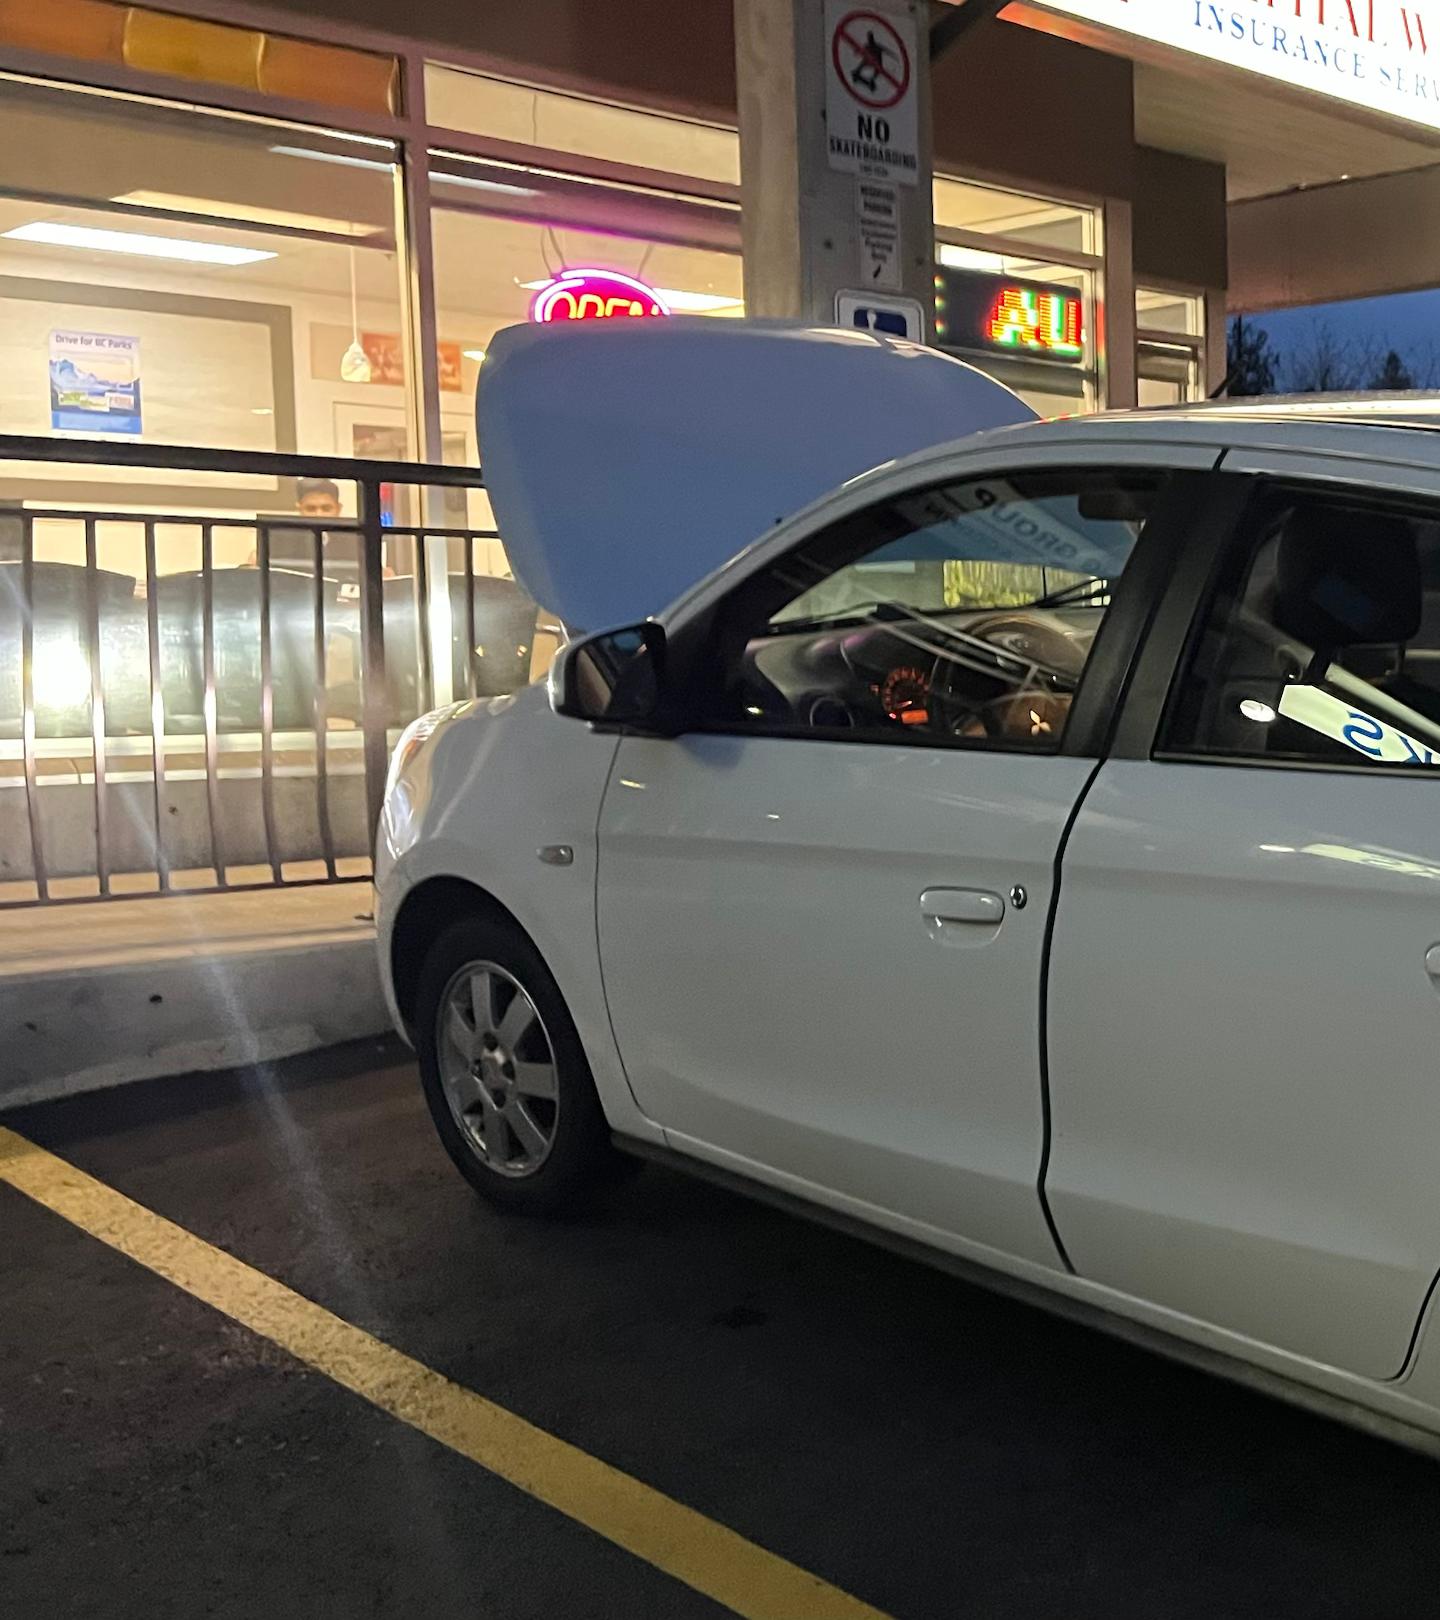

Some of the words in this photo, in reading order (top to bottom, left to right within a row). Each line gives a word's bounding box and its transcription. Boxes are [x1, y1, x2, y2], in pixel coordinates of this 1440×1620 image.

[1194, 1, 1366, 79] INSURANCE
[857, 112, 890, 144] NO
[829, 136, 918, 171] SKATEBOARDING
[55, 334, 79, 345] Drive
[80, 335, 93, 346] for
[108, 339, 132, 350] Parks
